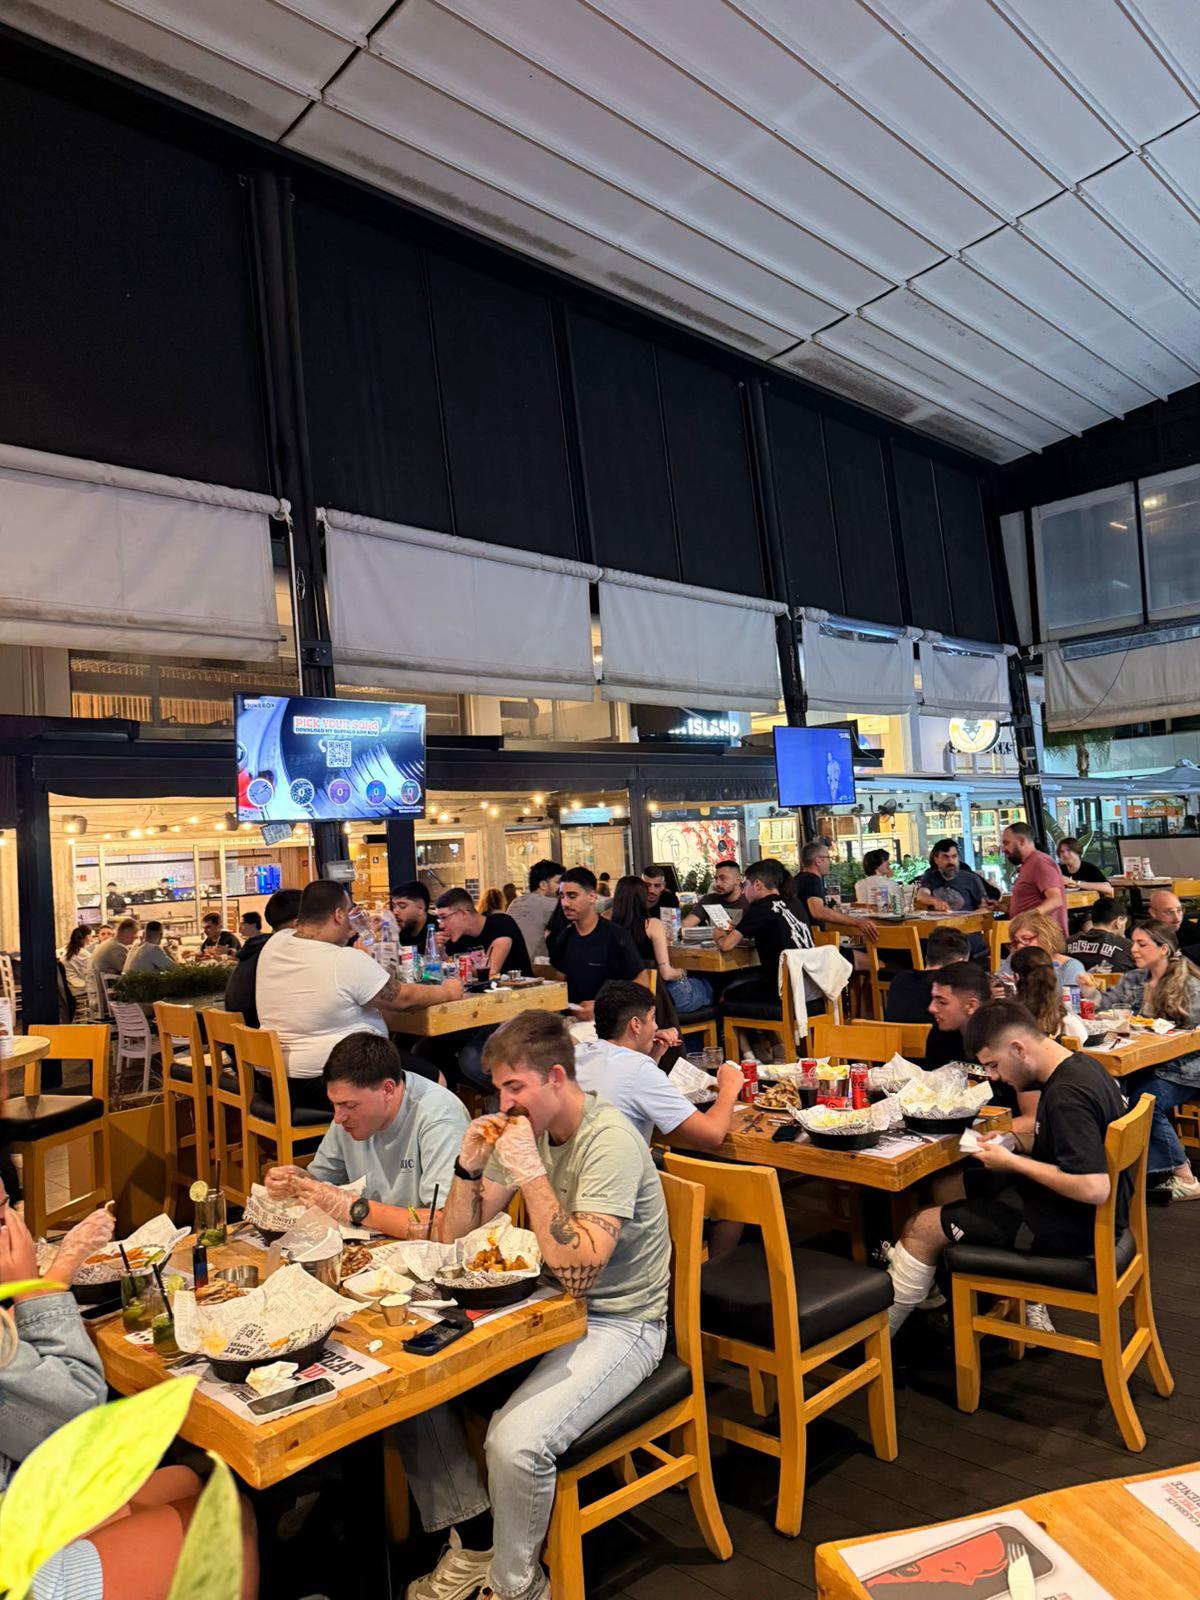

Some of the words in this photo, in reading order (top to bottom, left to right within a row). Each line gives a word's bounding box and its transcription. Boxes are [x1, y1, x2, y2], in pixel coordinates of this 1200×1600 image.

[296, 719, 319, 727] PICK
[322, 720, 349, 729] YOUR
[351, 720, 378, 730] SONG
[687, 717, 739, 737] ISLAND
[224, 1346, 251, 1356] SPLAT
[321, 1347, 365, 1376] REAT
